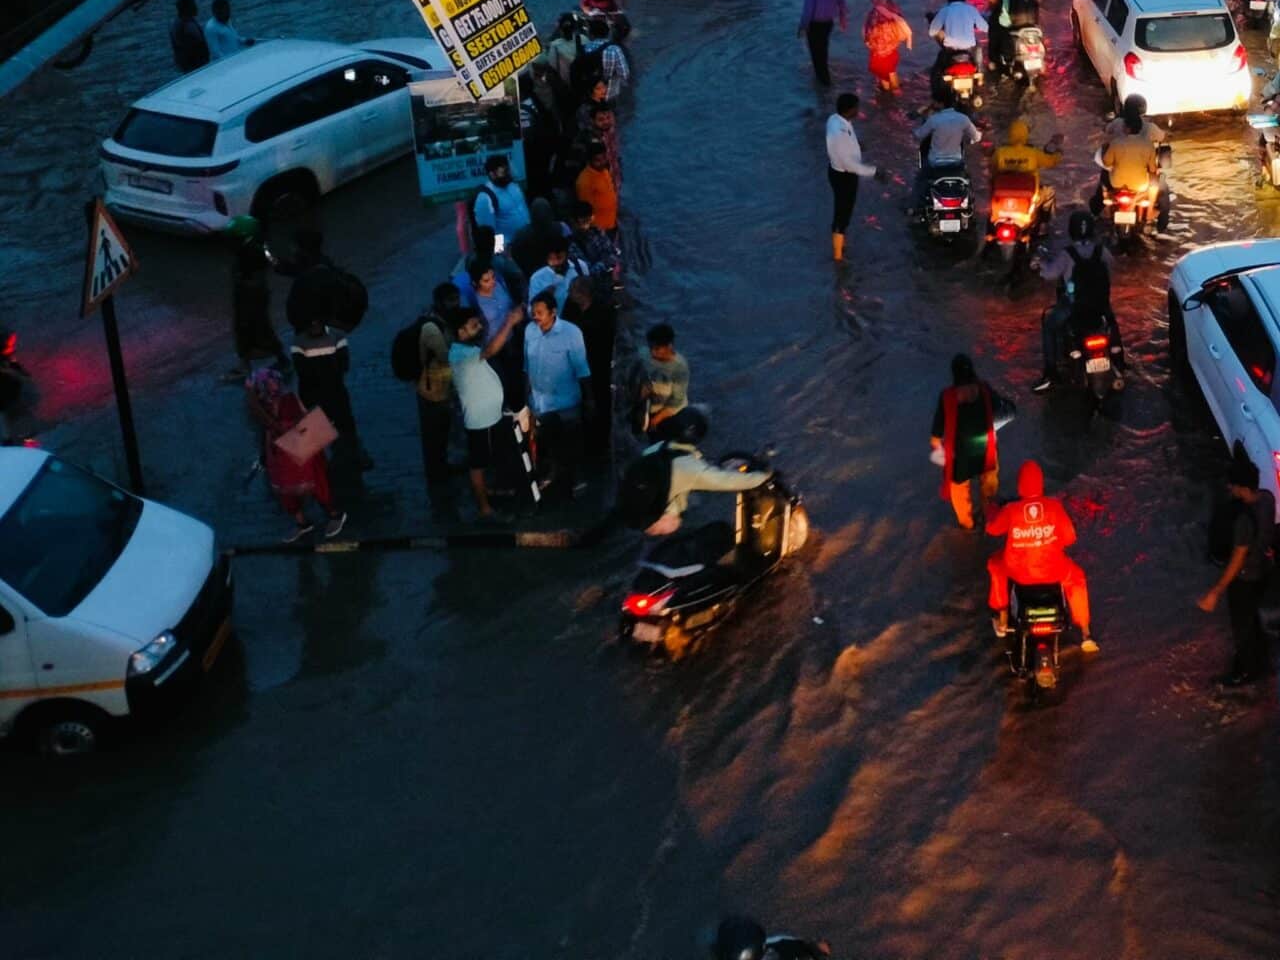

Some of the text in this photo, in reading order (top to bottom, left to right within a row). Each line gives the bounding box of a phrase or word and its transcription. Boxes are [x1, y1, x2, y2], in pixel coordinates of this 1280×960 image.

[453, 13, 476, 39] GET
[466, 8, 529, 57] SECTOR-14
[475, 50, 497, 71] GIFTS
[502, 35, 520, 54] GOLD
[518, 25, 534, 42] COIN
[482, 56, 514, 89] 85100
